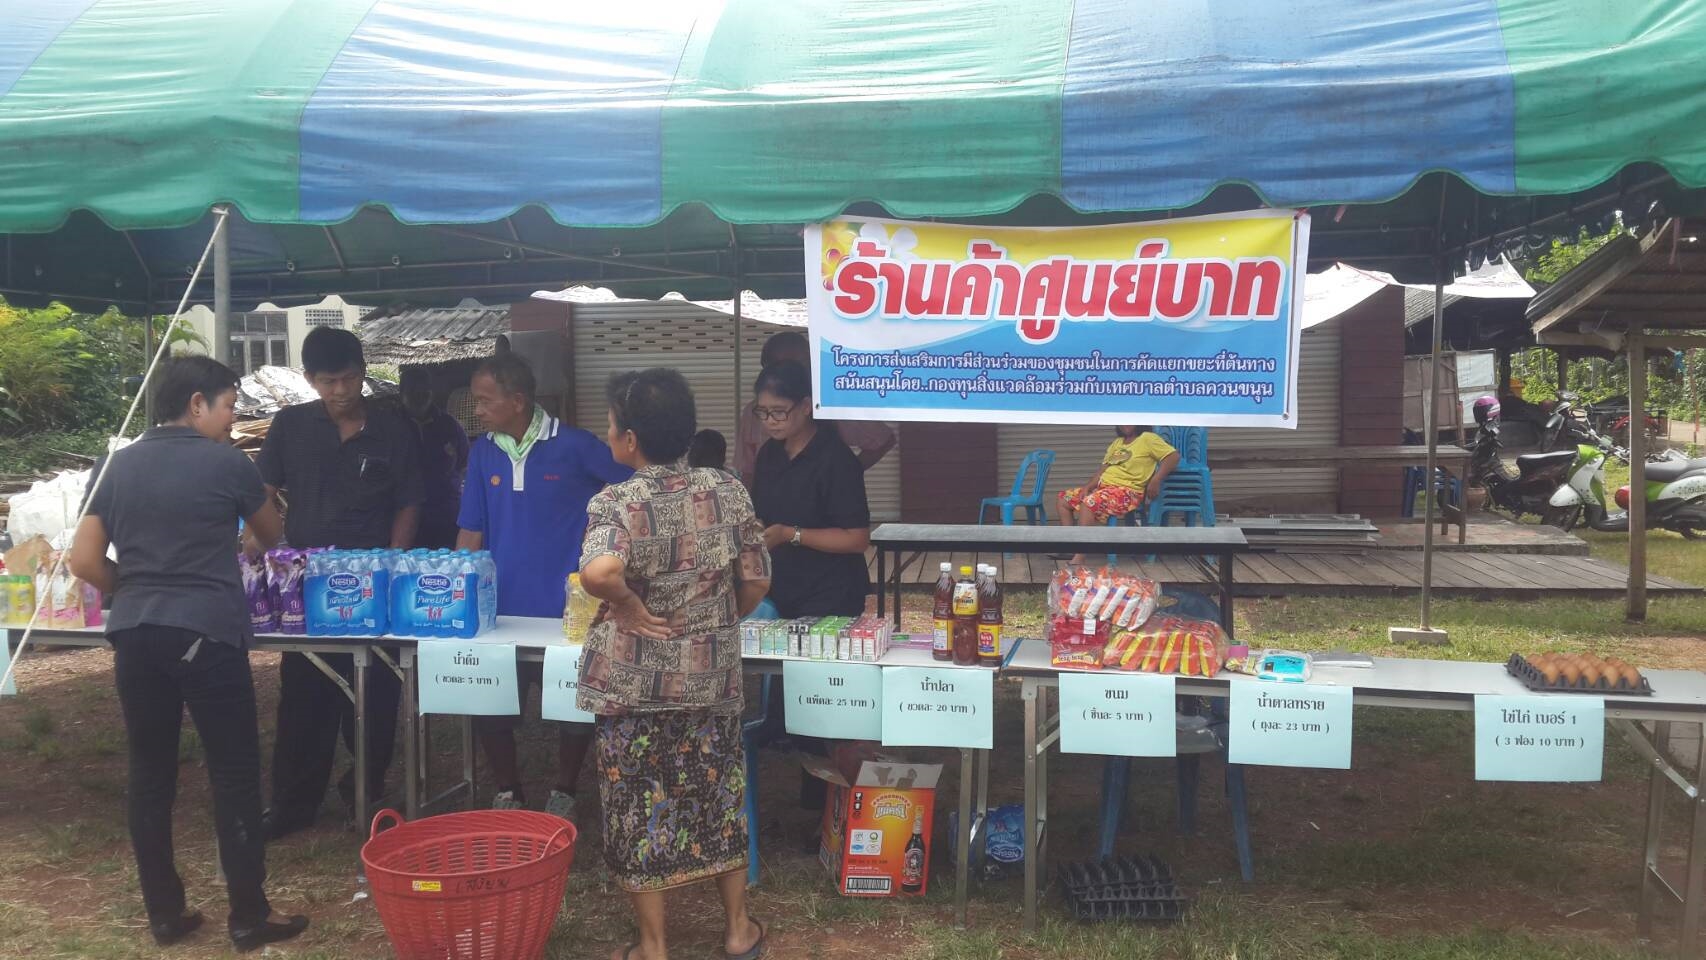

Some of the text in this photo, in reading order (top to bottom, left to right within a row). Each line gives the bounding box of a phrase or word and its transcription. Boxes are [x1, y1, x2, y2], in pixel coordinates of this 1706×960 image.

[834, 242, 1281, 340] ร้านค้าศูนย์บาท
[833, 347, 1275, 375] โครงการส่งเสริมการมีส่วนร่วมของชุมชนในการคัดแยกขยะที่ต้นทาง
[453, 648, 480, 666] น้ำดื่ม
[476, 677, 492, 685] บาท
[828, 677, 844, 686] นม
[921, 676, 955, 693] น้ำปลา
[1105, 689, 1128, 699] ขนม
[836, 698, 847, 706] 25
[851, 699, 867, 707] บาท
[1257, 692, 1325, 710] น้ำตาลทราย
[907, 703, 932, 711] ขวดละ
[951, 705, 968, 713] บาท
[1125, 712, 1144, 720] บาท
[1501, 709, 1576, 725] ไข่ไก่ เบอร์ 1
[1260, 720, 1282, 732] ถุงละ
[1286, 723, 1298, 731] 23
[1302, 723, 1321, 732] บาท
[1505, 737, 1510, 745] 3
[1515, 735, 1534, 746] ฟอง
[1540, 738, 1551, 746] 10
[1555, 738, 1575, 747] บาท
